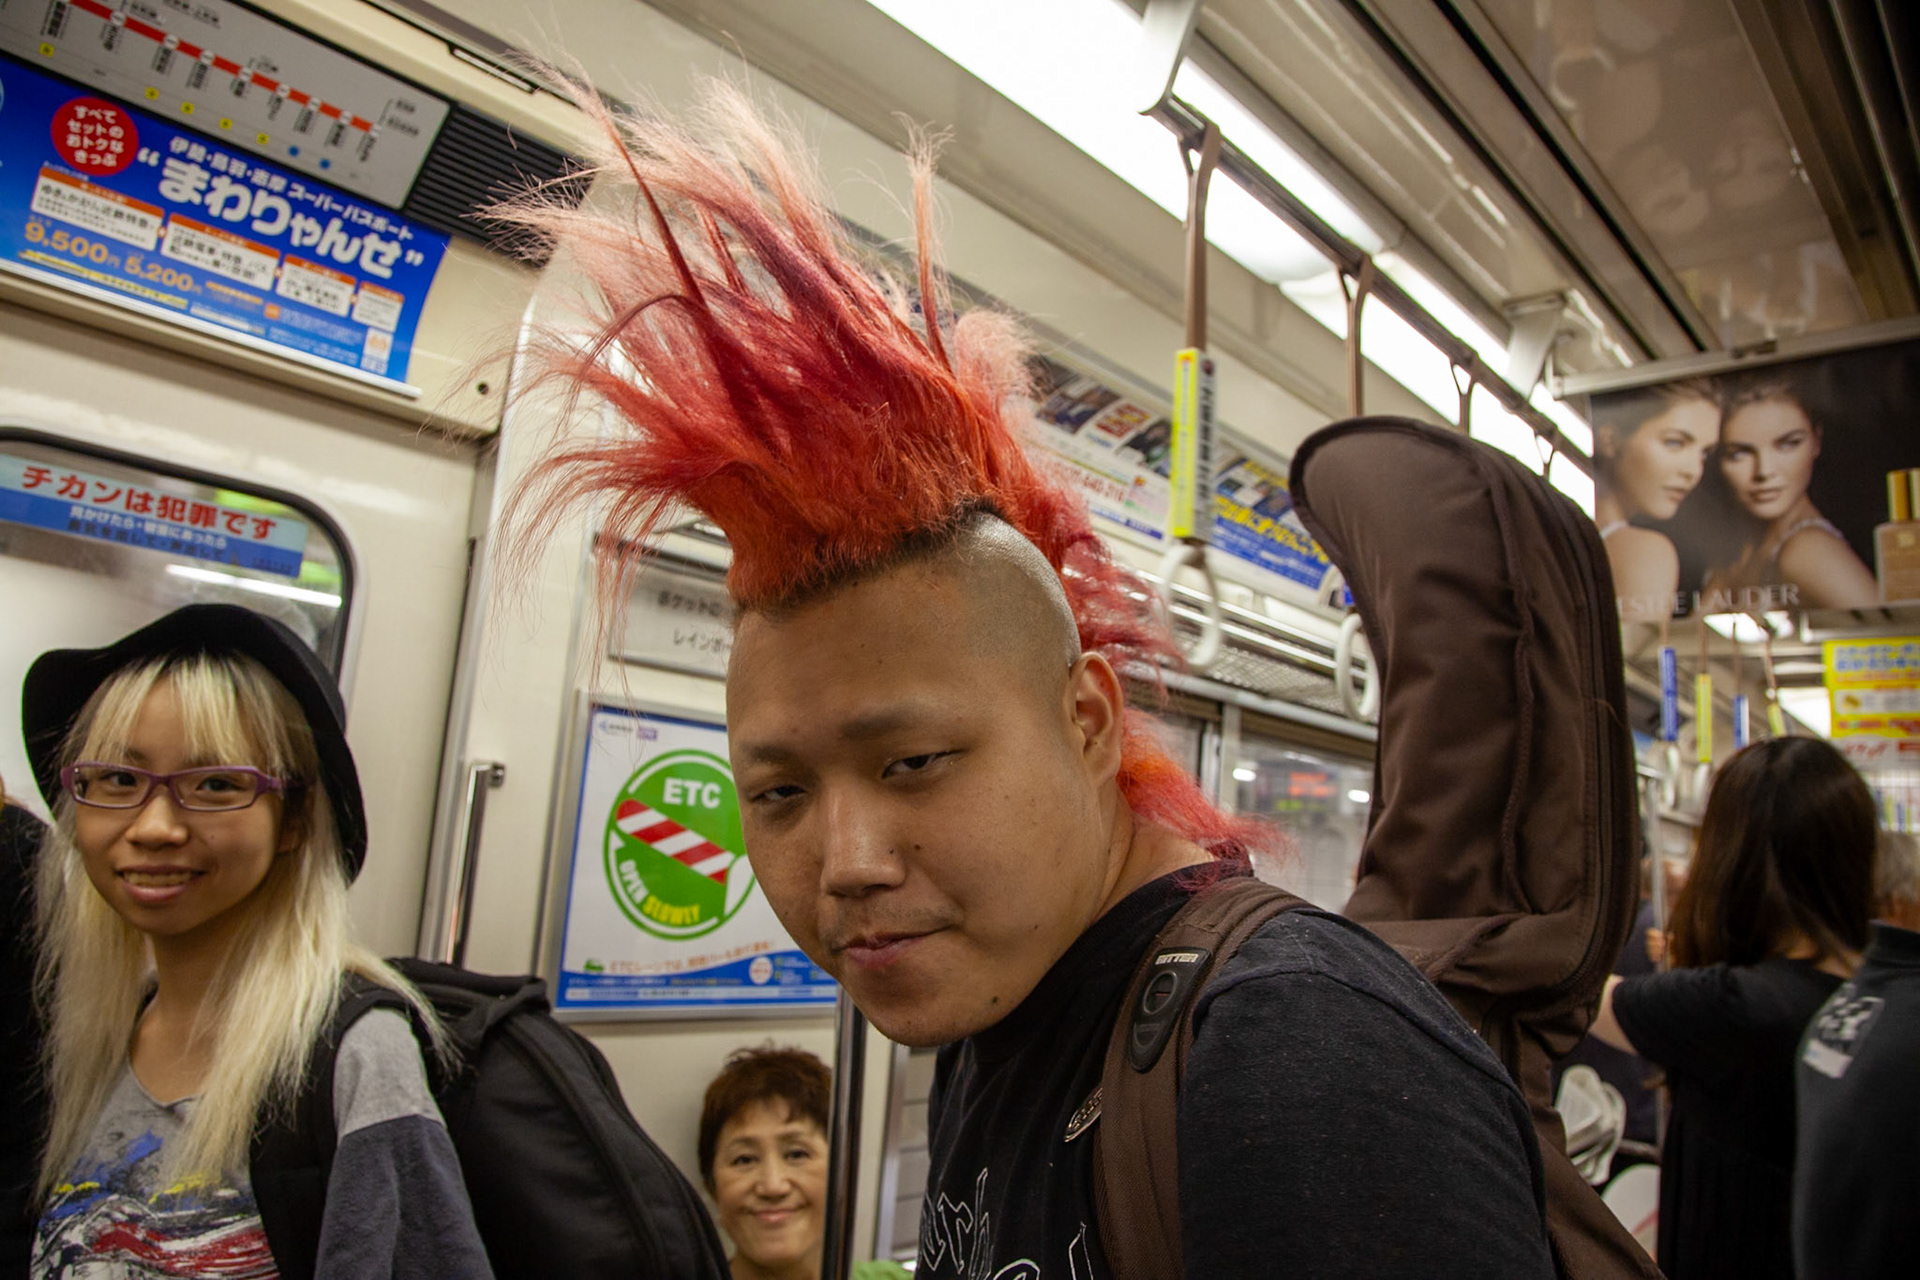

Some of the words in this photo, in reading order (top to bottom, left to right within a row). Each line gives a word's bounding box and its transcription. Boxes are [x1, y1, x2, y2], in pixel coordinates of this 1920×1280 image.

[66, 119, 125, 140] セットの
[74, 105, 117, 124] すべて
[66, 134, 125, 154] おトクな
[74, 149, 118, 168] きっぷ
[287, 182, 414, 241] スーパーパスポート
[22, 465, 278, 541] チカンは犯罪です
[1692, 582, 1801, 615] LAUDER
[662, 776, 722, 809] ETC
[619, 858, 650, 905] OPEN
[642, 895, 700, 926] SLOWLY
